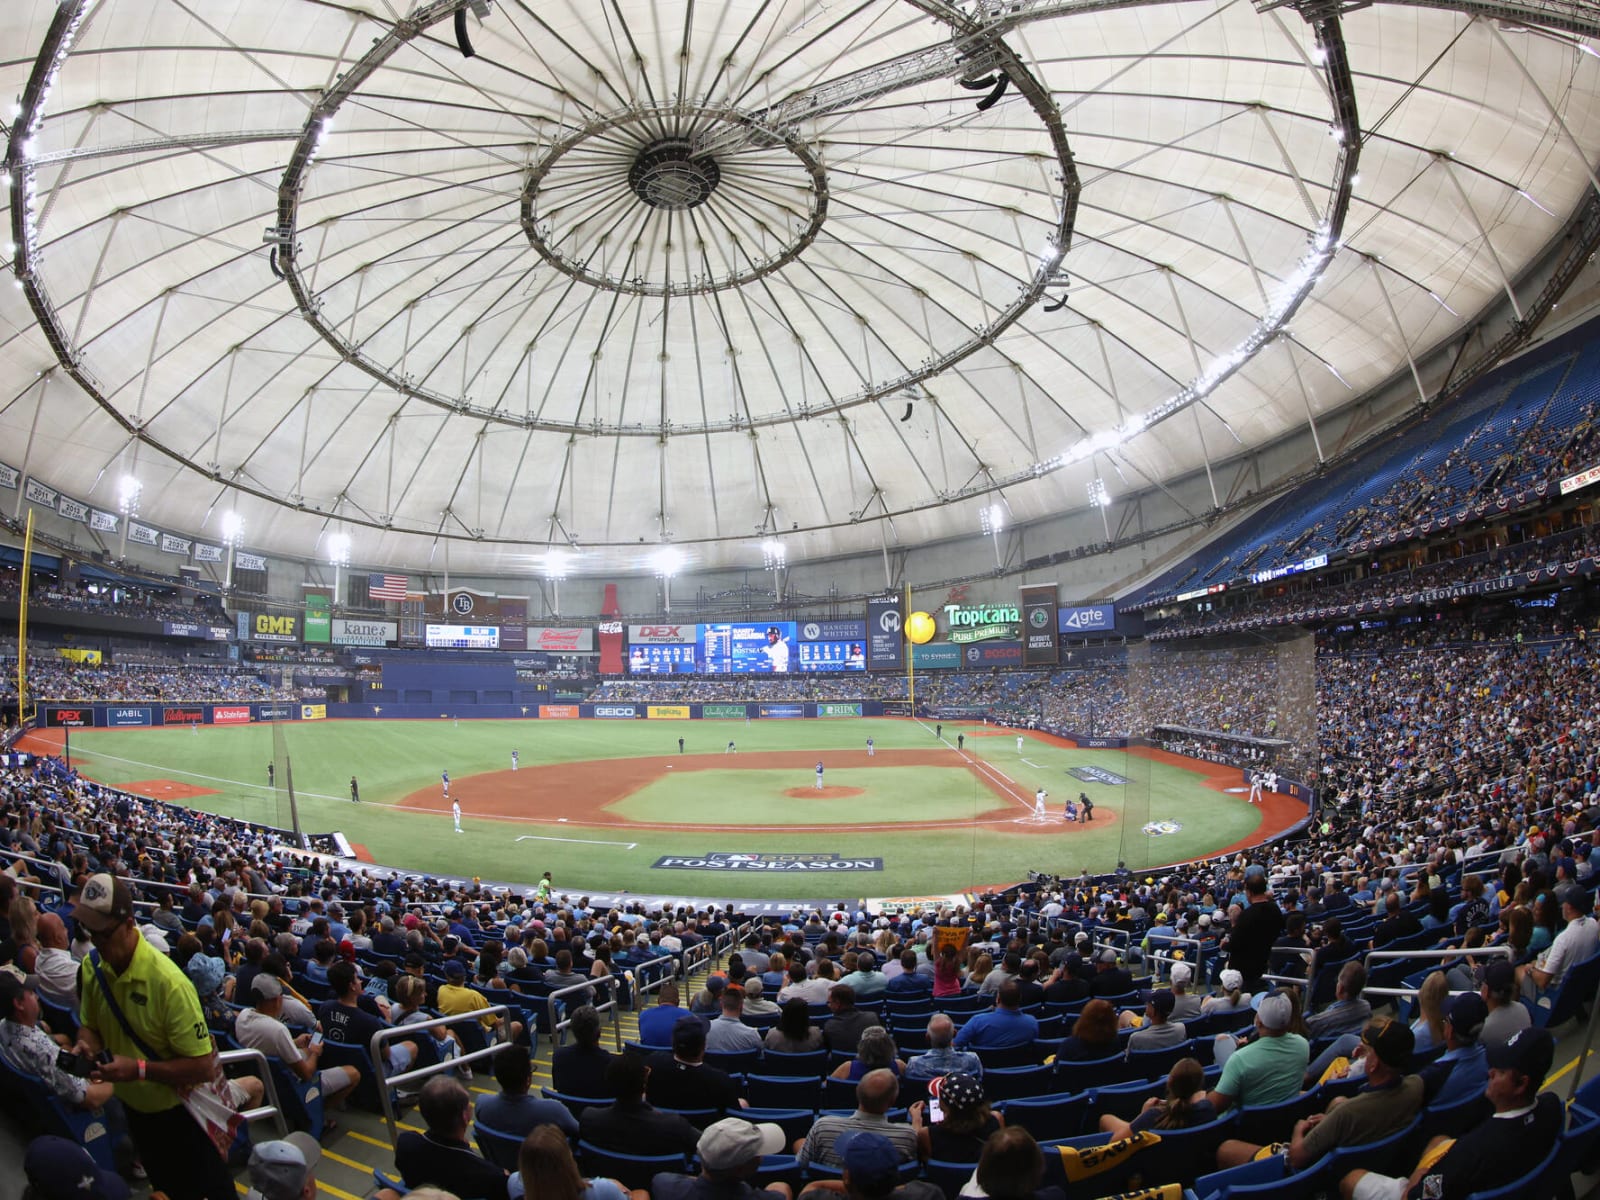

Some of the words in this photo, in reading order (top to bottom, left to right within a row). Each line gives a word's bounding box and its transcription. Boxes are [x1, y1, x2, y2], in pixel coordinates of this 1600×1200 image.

[1419, 586, 1479, 602] AEROVANTI
[1484, 578, 1513, 591] CLUB
[457, 597, 470, 610] TB
[944, 604, 1019, 627] Tropicana
[256, 615, 296, 635] GMF
[640, 626, 681, 637] DEX
[953, 632, 974, 640] PURE
[975, 627, 1010, 638] PREMIUM
[984, 648, 1020, 658] BOSCH
[57, 710, 81, 720] DEX
[596, 708, 634, 716] GEICO
[834, 706, 854, 714] RIPA
[662, 858, 875, 870] POSTSEASON
[331, 1011, 350, 1026] LOWE
